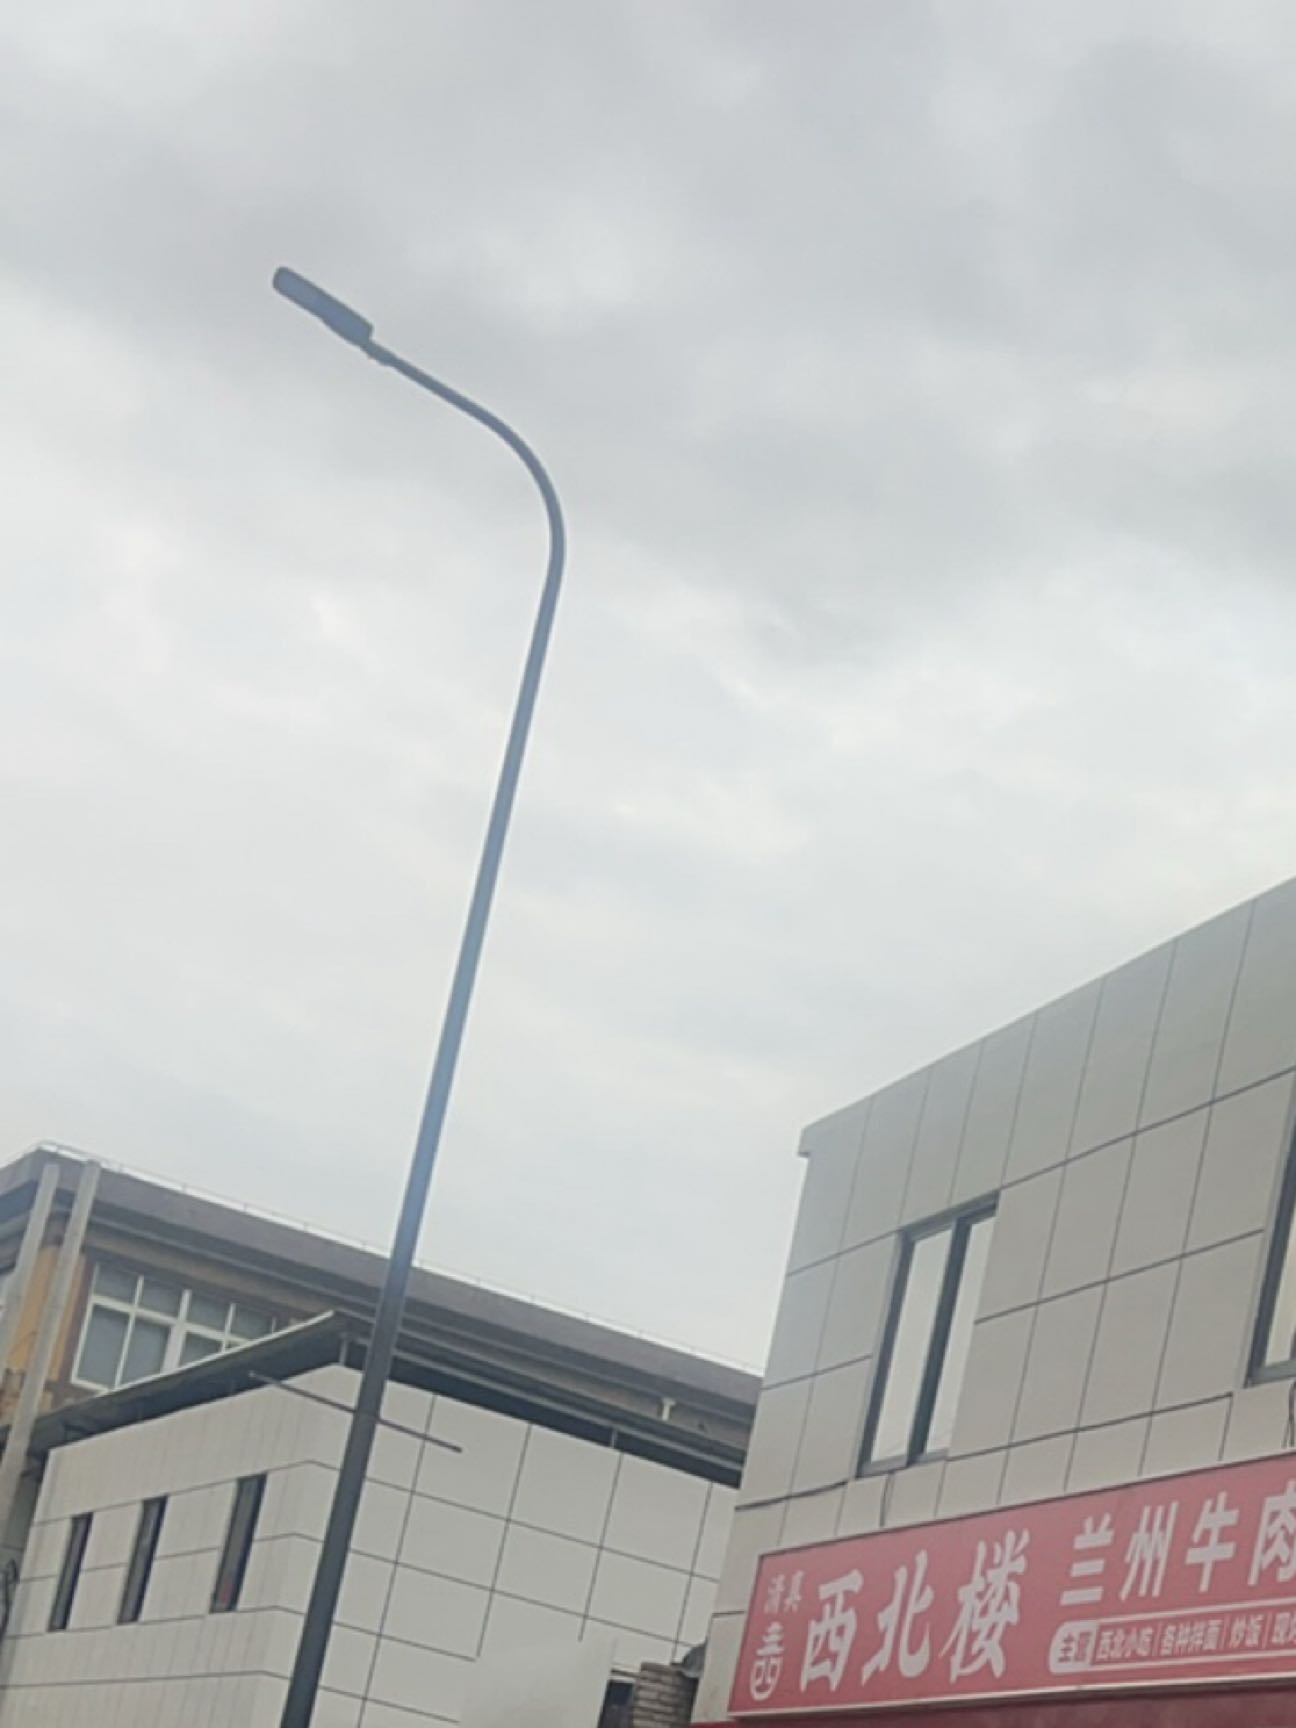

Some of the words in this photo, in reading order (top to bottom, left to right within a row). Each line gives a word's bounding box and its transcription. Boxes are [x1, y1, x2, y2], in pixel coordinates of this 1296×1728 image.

[799, 1528, 1031, 1693] 西北楼
[1096, 1624, 1155, 1661] 西北小吃
[1159, 1618, 1224, 1656] 各种拌面
[1229, 1613, 1265, 1649] 炒饭
